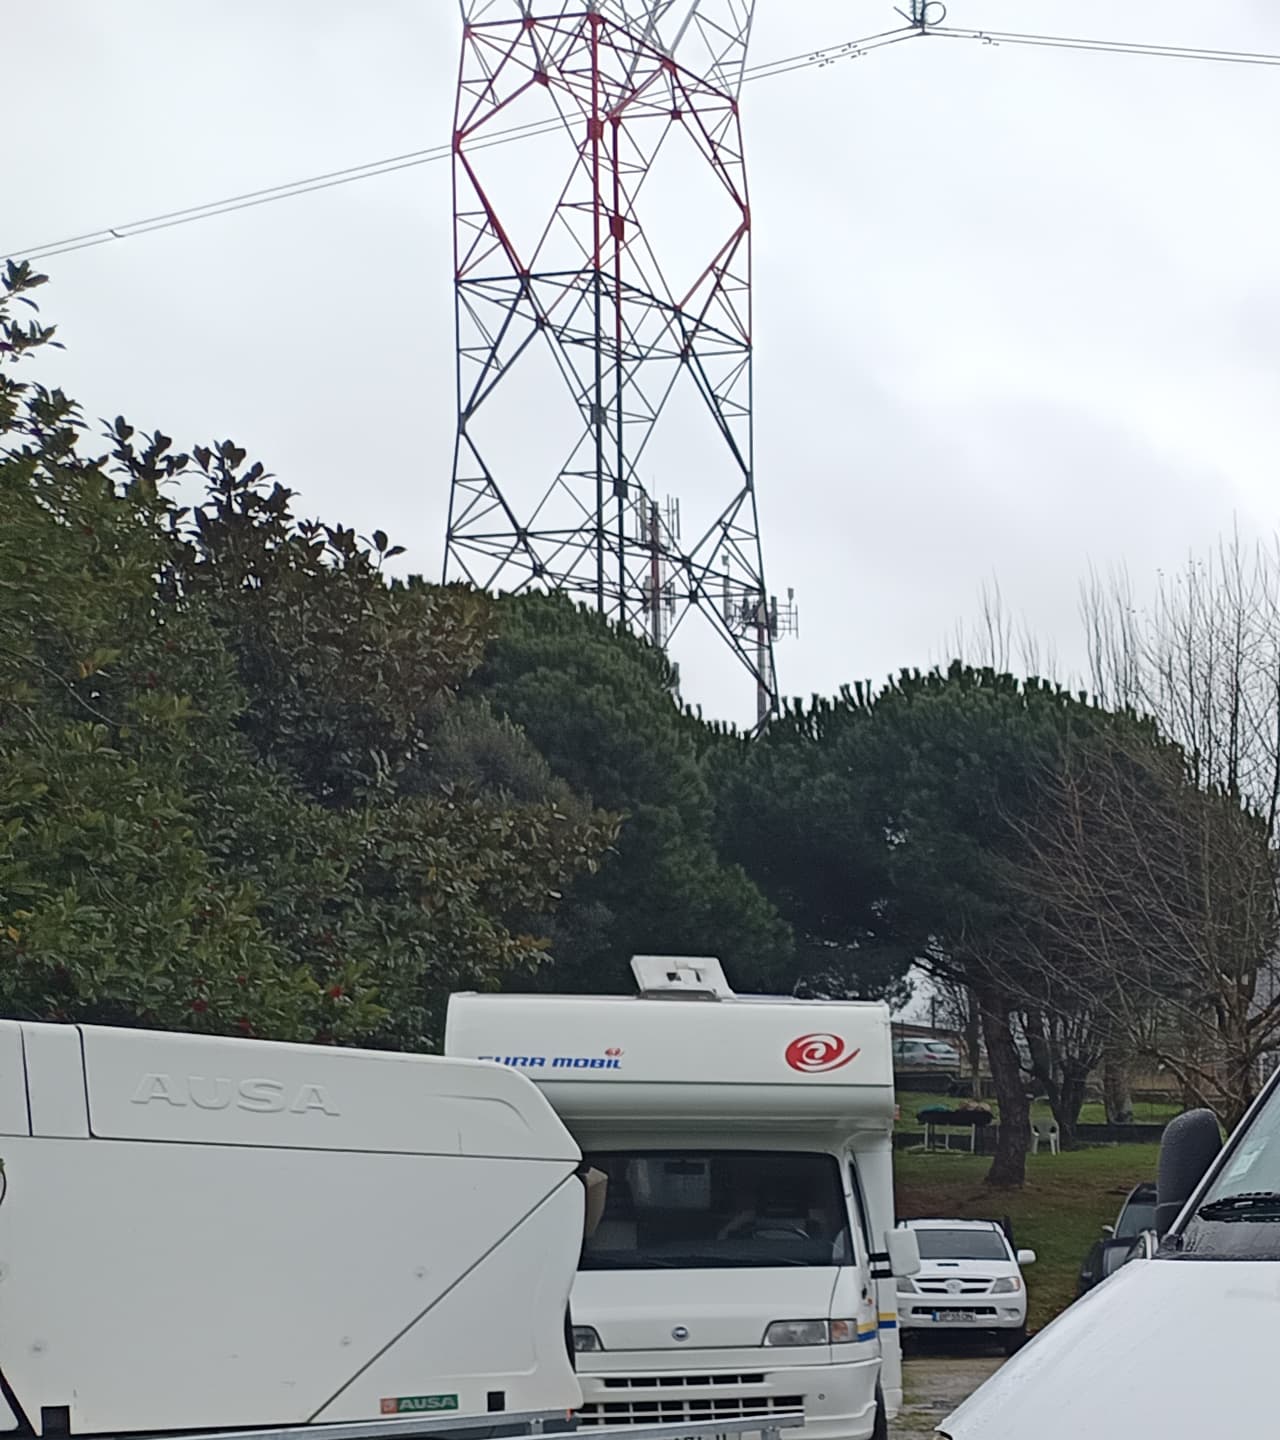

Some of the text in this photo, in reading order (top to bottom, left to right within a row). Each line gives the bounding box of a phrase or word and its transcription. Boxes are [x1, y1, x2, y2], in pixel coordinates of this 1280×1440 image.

[477, 1056, 622, 1069] URA MOBIL
[129, 1072, 342, 1117] AUSA
[399, 1396, 456, 1411] AUSA
